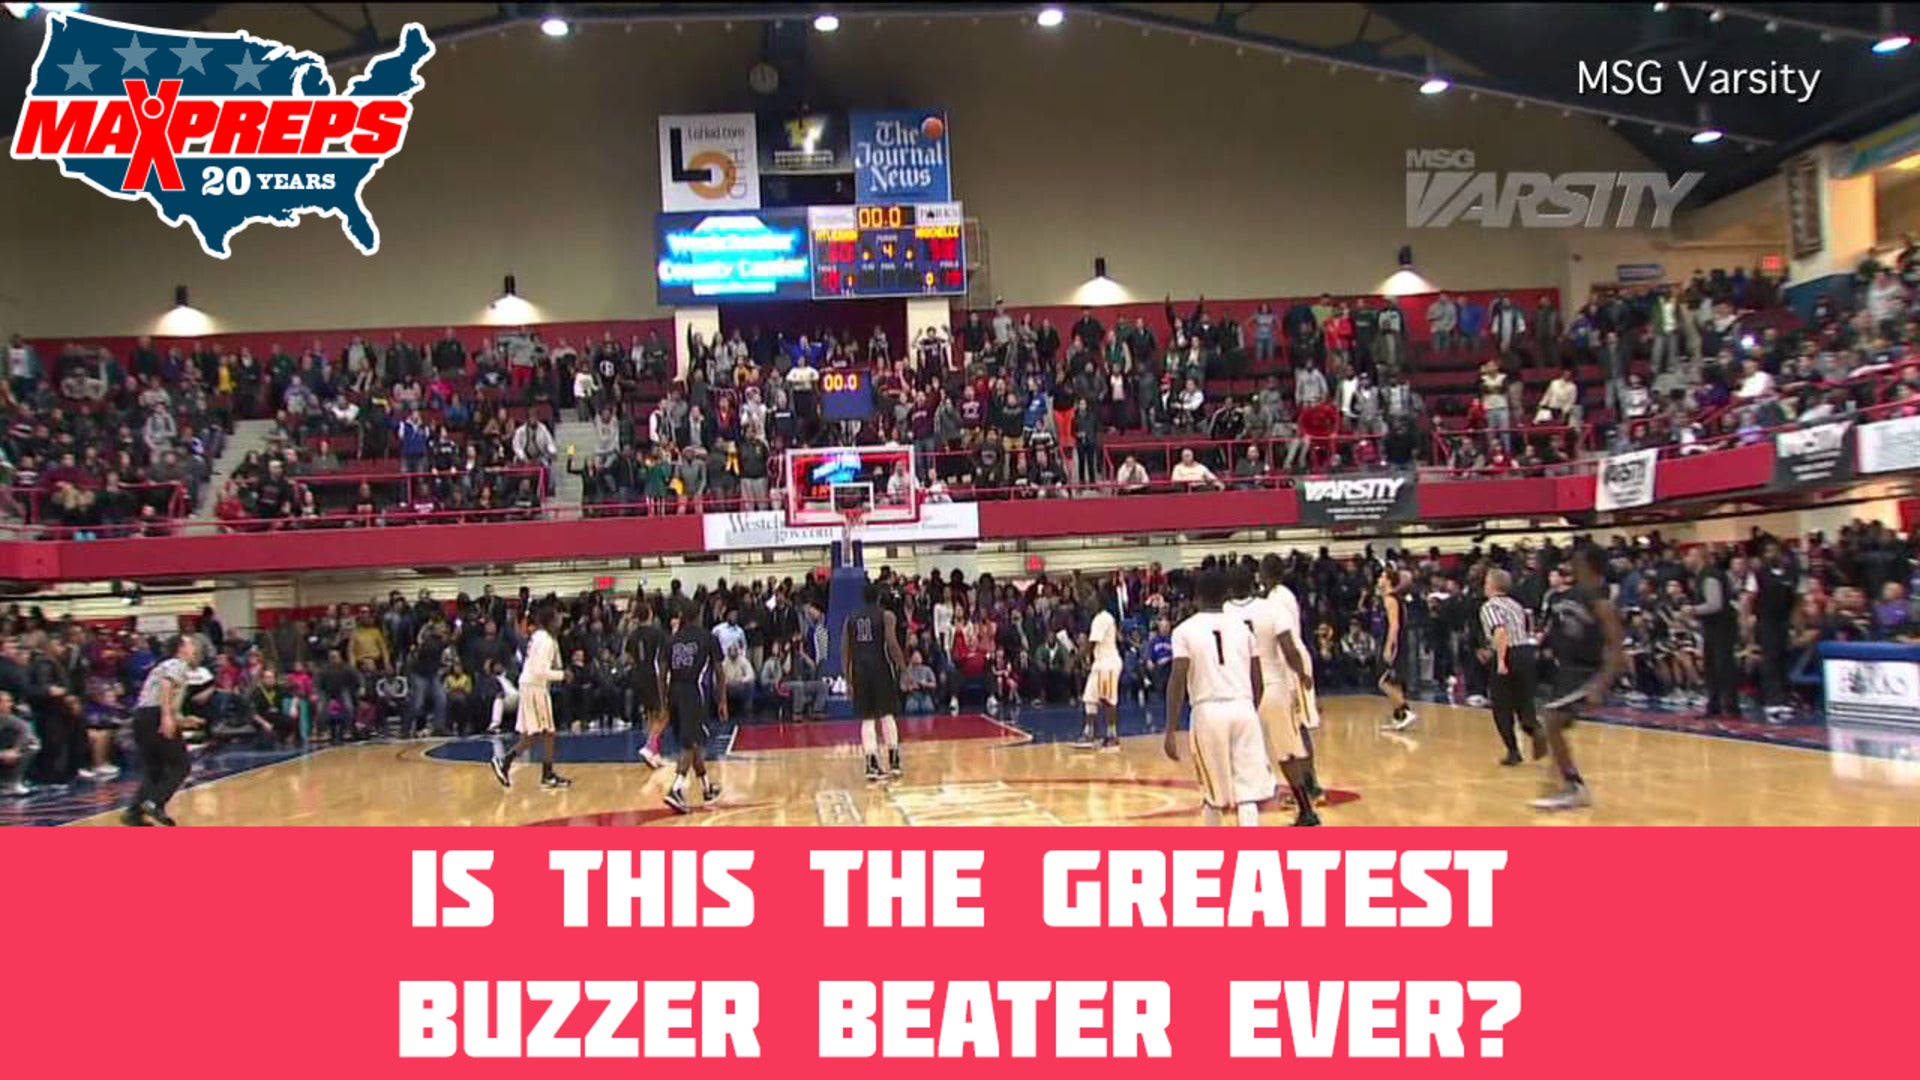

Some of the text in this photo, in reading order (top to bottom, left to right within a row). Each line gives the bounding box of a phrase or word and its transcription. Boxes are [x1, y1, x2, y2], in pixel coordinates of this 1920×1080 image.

[875, 119, 920, 146] The
[855, 140, 944, 169] Journal
[870, 165, 932, 192] News
[1303, 477, 1406, 502] VARSITY
[1211, 629, 1225, 666] 1
